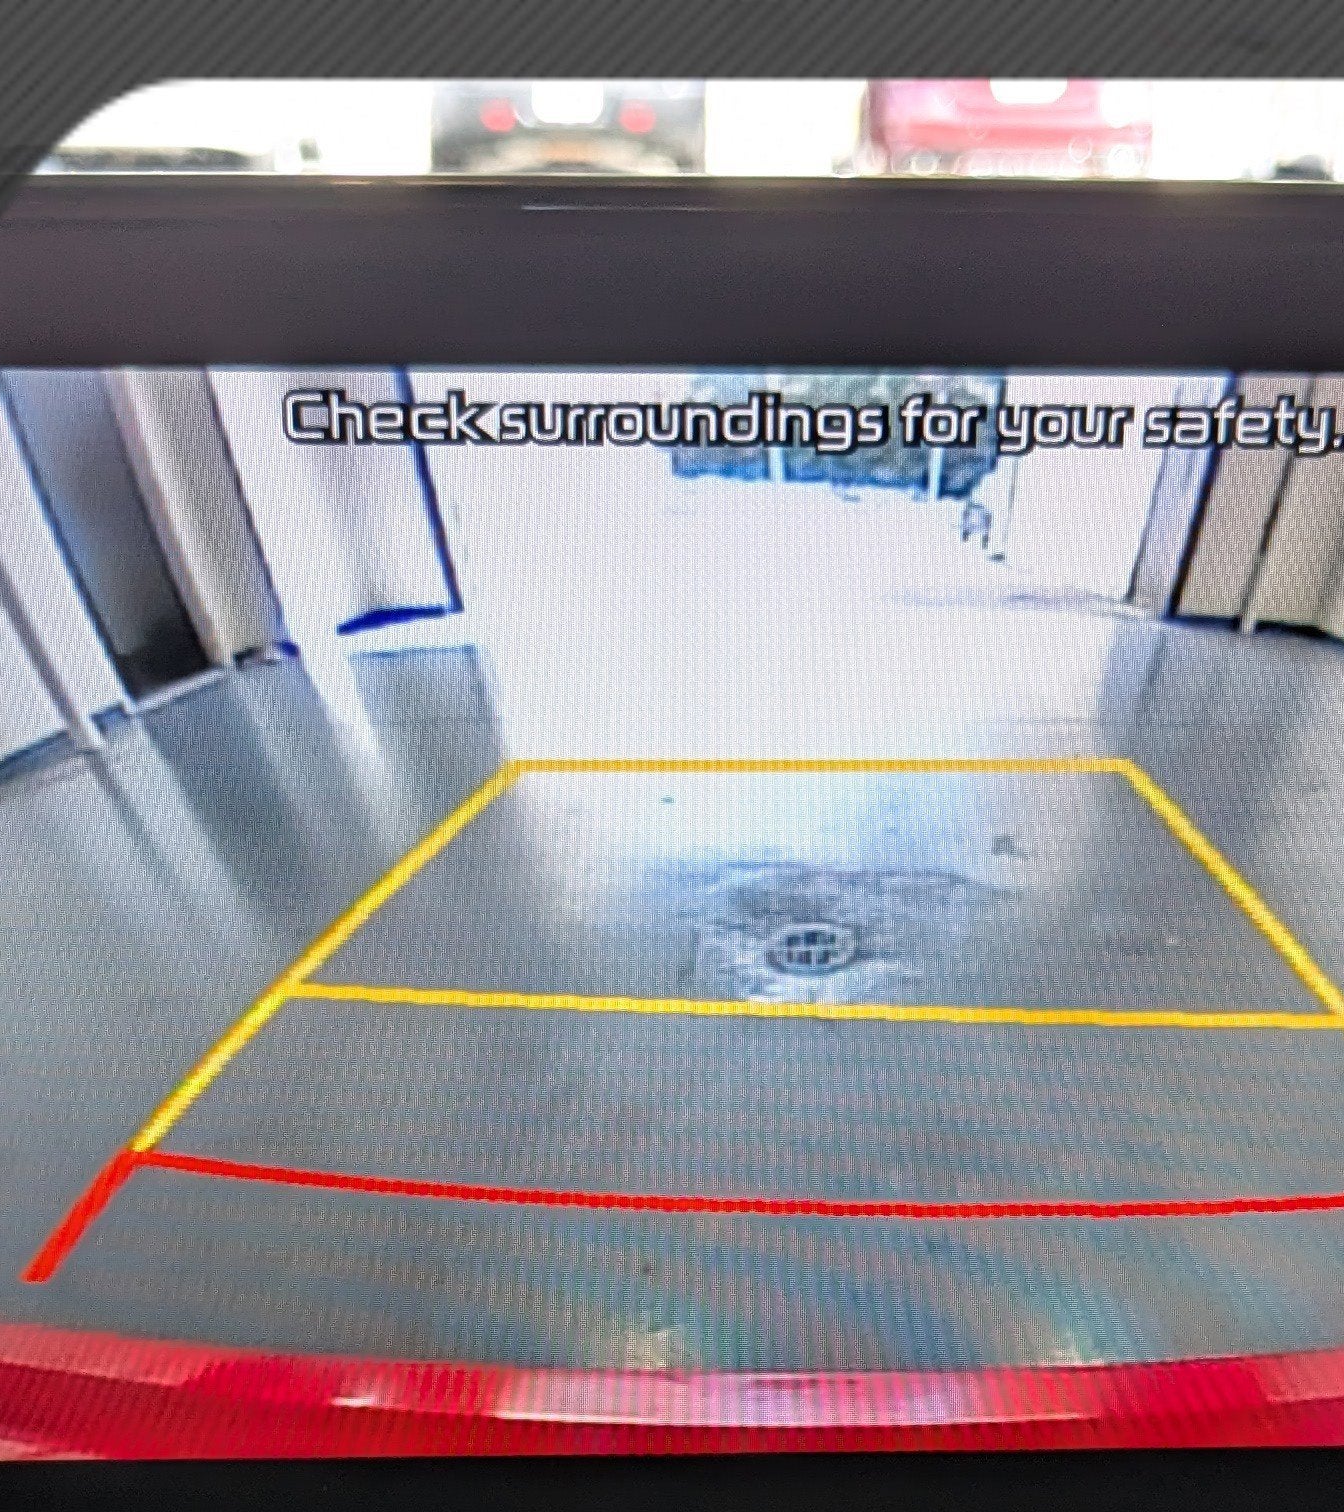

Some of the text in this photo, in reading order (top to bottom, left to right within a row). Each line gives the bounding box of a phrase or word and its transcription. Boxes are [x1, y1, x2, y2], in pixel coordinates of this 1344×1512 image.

[284, 390, 488, 444] Check
[498, 390, 886, 452] surroundings
[901, 396, 981, 448] for
[997, 403, 1132, 453] your
